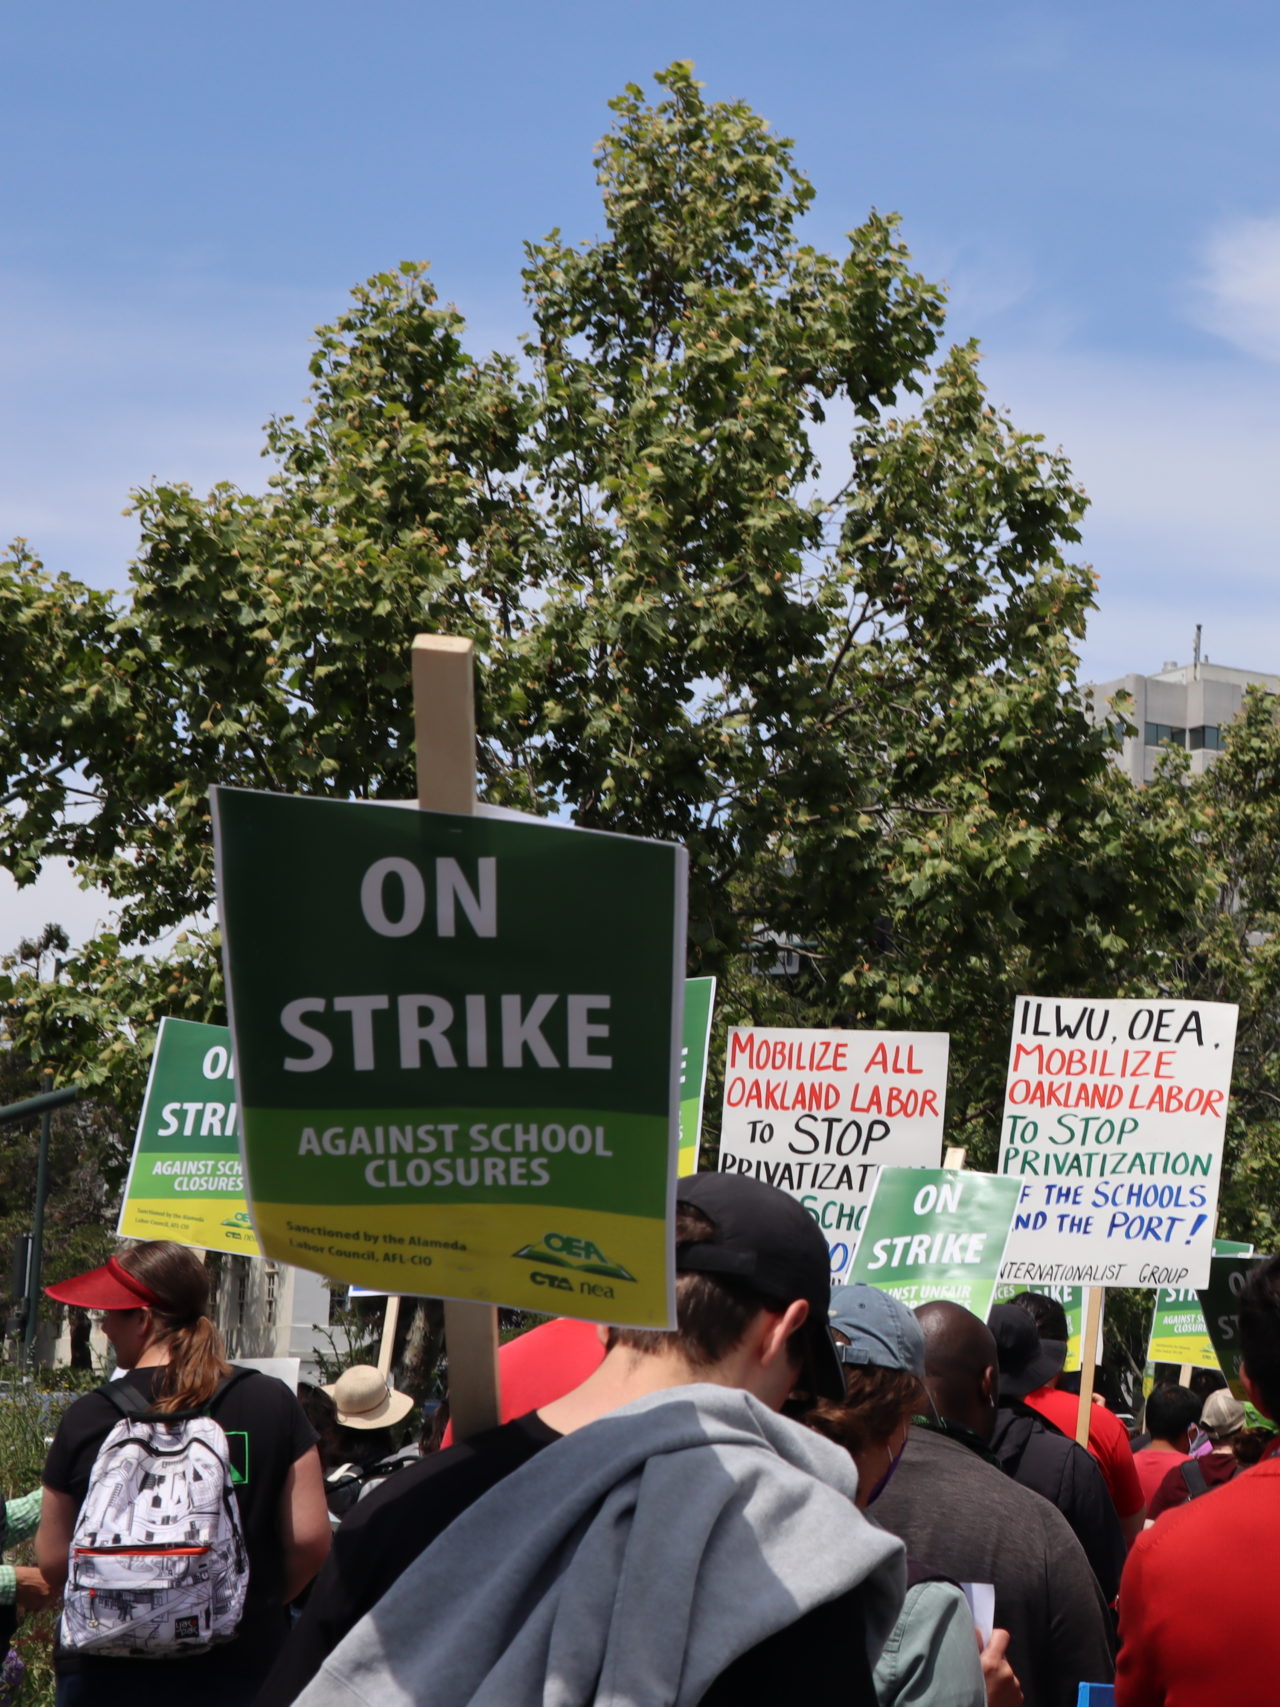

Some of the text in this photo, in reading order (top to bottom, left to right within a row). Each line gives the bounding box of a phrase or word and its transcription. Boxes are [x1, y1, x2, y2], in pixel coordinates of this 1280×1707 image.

[360, 856, 498, 938] ON
[280, 993, 613, 1071] STRIKE
[1020, 1000, 1117, 1045] ILWU,
[730, 1032, 848, 1072] MOBILIZE
[864, 1042, 923, 1074] ALL
[1013, 1043, 1177, 1079] MOBILIZE
[726, 1077, 939, 1118] OAKLAND LABOR
[1008, 1079, 1225, 1118] OAKLAND LABOR
[157, 1102, 241, 1137] STRI
[748, 1114, 891, 1156] TO STOP
[1048, 1113, 1139, 1147] STOP
[298, 1124, 613, 1157] AGAINST SCHOOL
[152, 1161, 243, 1175] AGAINST SCH
[364, 1157, 551, 1188] CLOSURES
[721, 1153, 884, 1193] PRIVATIZAT
[1003, 1147, 1213, 1178] PRIVATIZATION
[174, 1176, 244, 1191] CLOSURES
[914, 1183, 964, 1216] ON
[1045, 1184, 1084, 1205] THE
[1091, 1181, 1207, 1208] SCHOOLS
[234, 1212, 250, 1223] OE
[1011, 1211, 1047, 1231] ND
[1057, 1213, 1094, 1234] THE
[286, 1221, 467, 1252] Sanctioned by the Alameda
[289, 1238, 325, 1254] Labor
[328, 1245, 379, 1263] Council,
[542, 1232, 610, 1265] OEA
[867, 1232, 987, 1270] STRIKE
[529, 1271, 615, 1299] CTA nea
[999, 1262, 1189, 1285] NTERNATIONALIST GROUP
[920, 1284, 972, 1299] UNFAIR
[1162, 1314, 1196, 1325] AGAINST
[1174, 1323, 1208, 1333] CLOSURE
